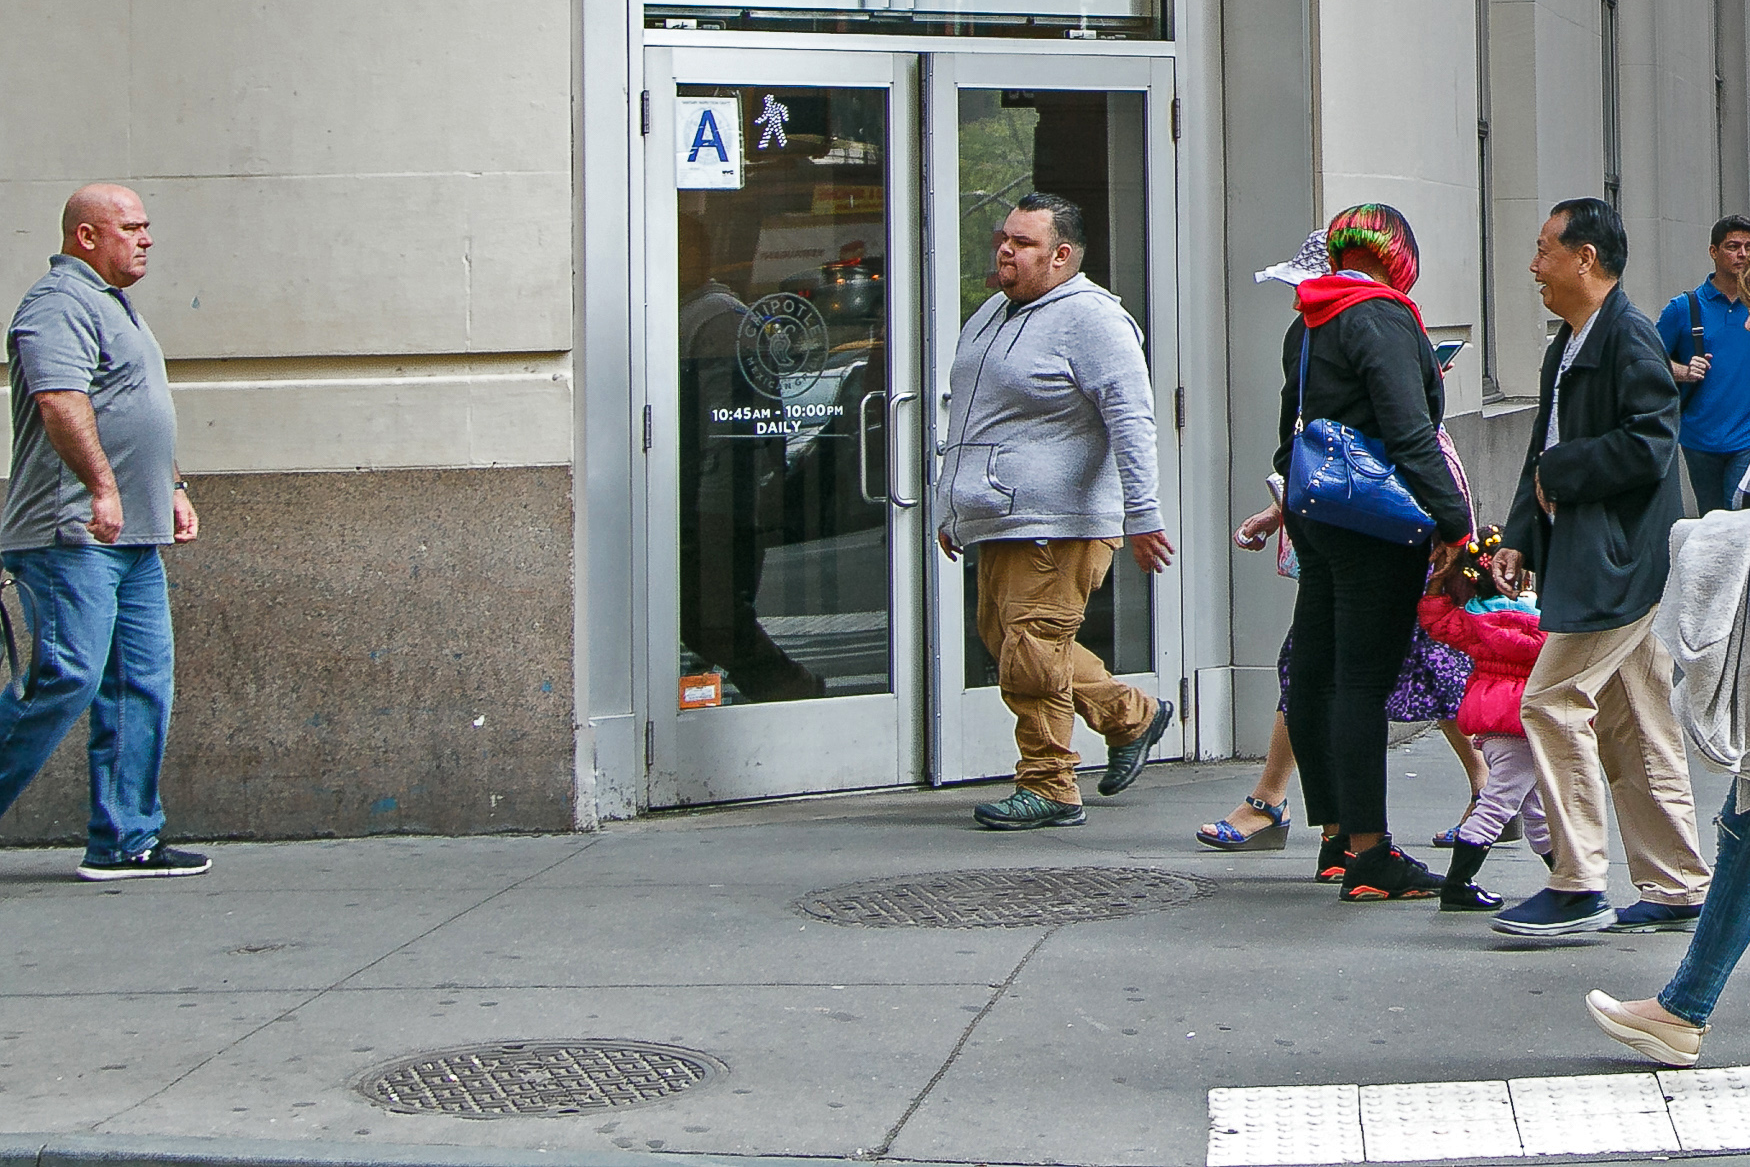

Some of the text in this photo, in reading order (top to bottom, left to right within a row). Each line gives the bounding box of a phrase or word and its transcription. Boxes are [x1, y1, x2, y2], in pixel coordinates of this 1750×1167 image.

[687, 109, 730, 163] A
[745, 299, 823, 338] CHIPOTLE
[711, 407, 771, 422] 10:45AM
[785, 403, 844, 419] 10:00PM
[756, 420, 802, 435] DAILY
